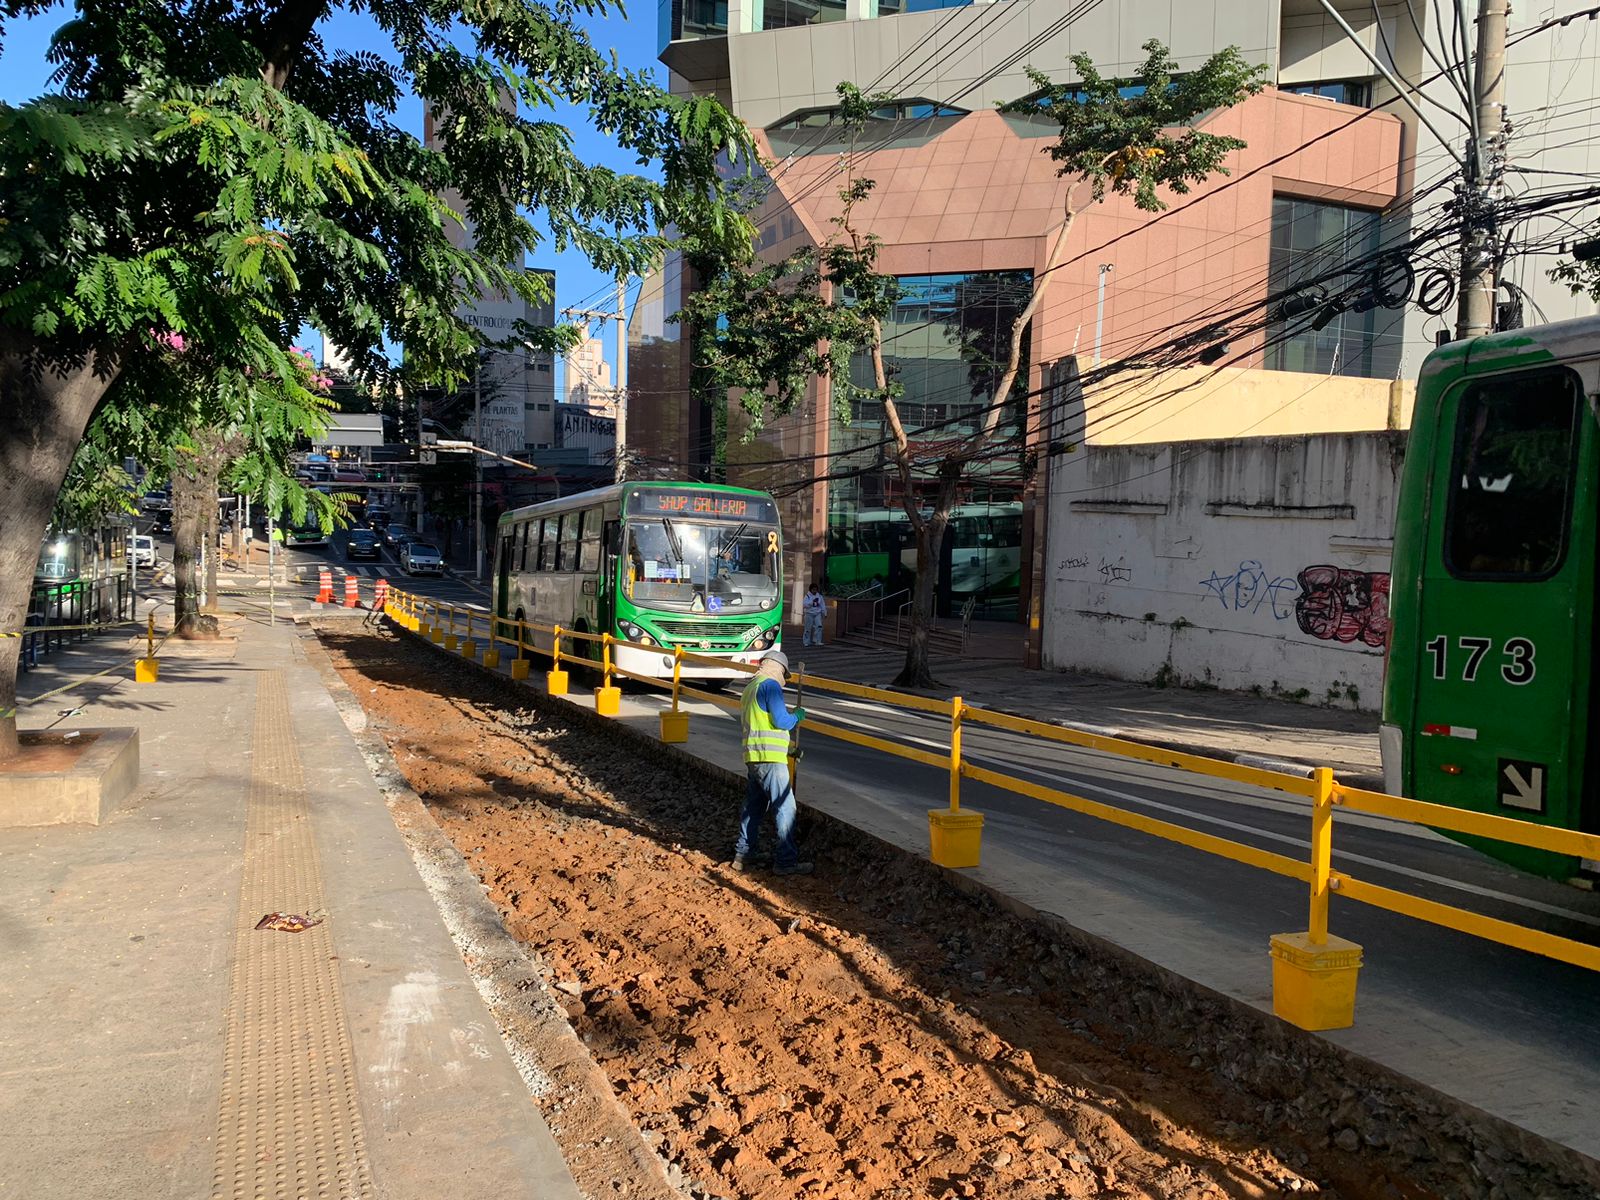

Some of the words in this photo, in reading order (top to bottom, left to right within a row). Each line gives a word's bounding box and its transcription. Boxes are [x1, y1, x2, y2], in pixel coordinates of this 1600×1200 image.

[694, 497, 747, 515] GALLERIA
[742, 625, 762, 642] 203
[1426, 635, 1536, 685] 173
